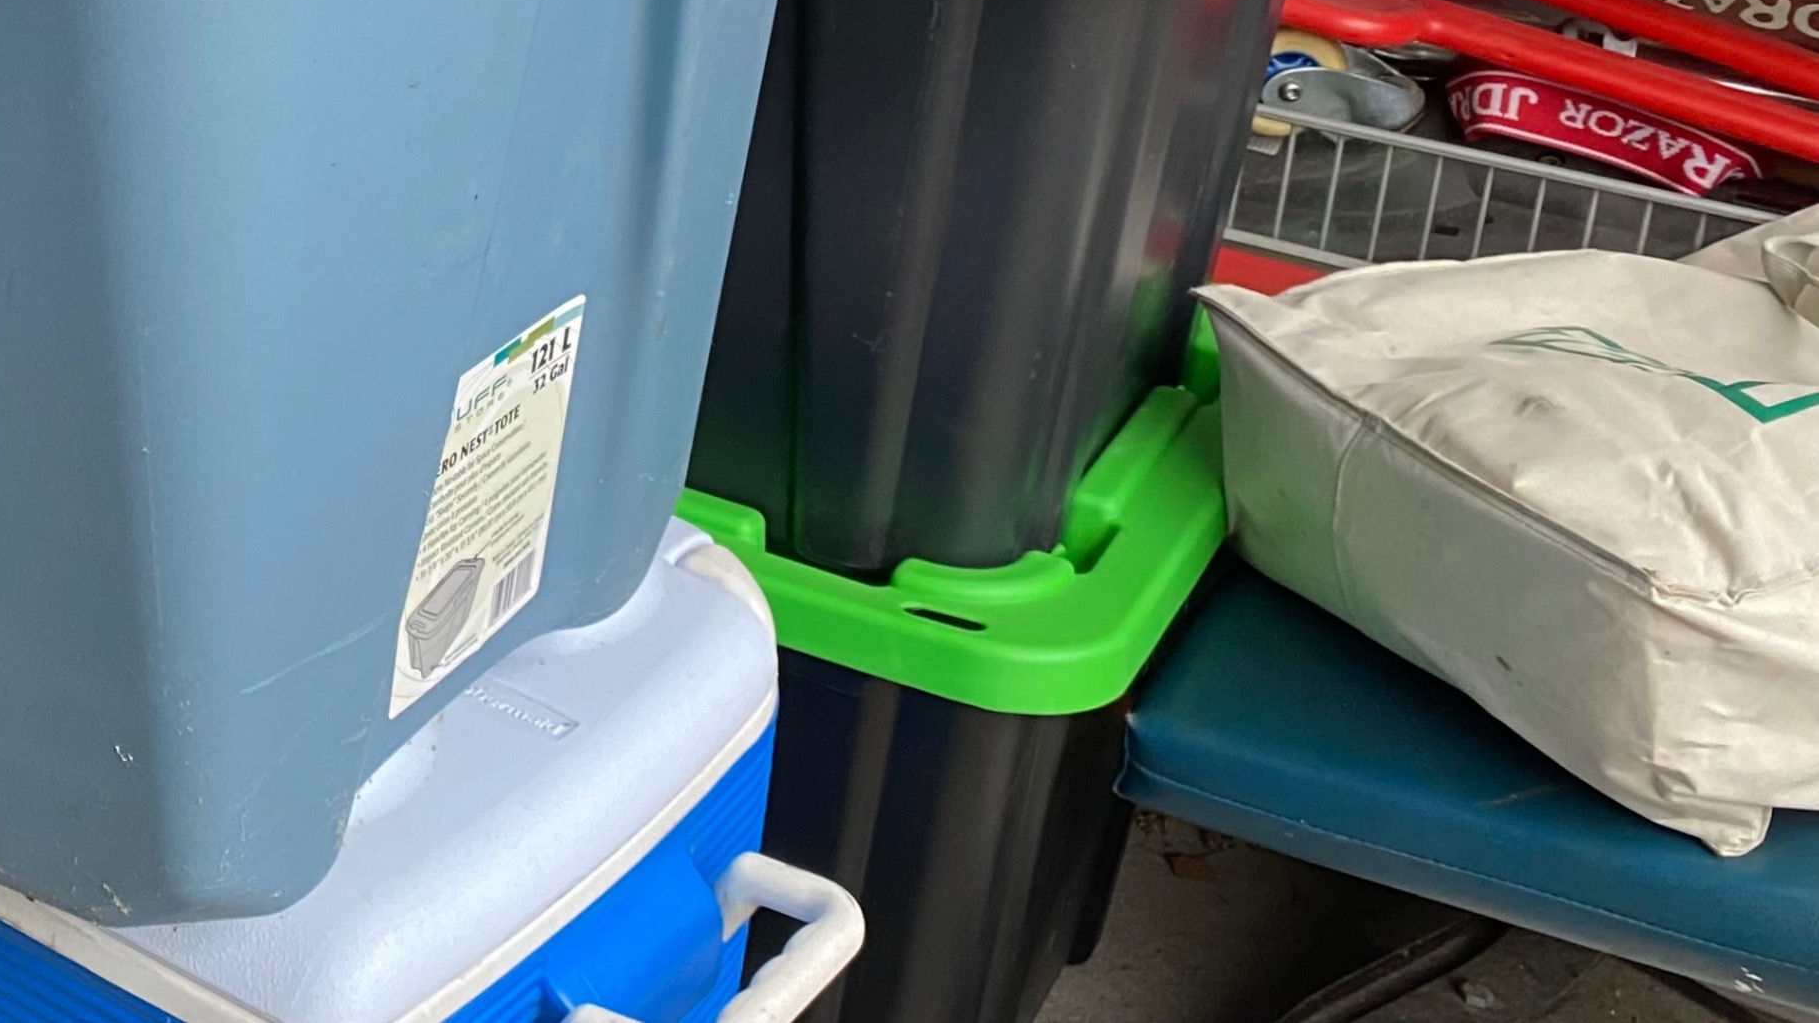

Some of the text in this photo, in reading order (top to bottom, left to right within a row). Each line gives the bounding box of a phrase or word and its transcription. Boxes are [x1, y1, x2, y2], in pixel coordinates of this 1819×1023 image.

[1559, 98, 1732, 189] RAZOR
[531, 326, 572, 374] 121 L
[533, 356, 570, 395] 32 Gal
[437, 451, 458, 476] RO
[495, 403, 521, 435] TOTE
